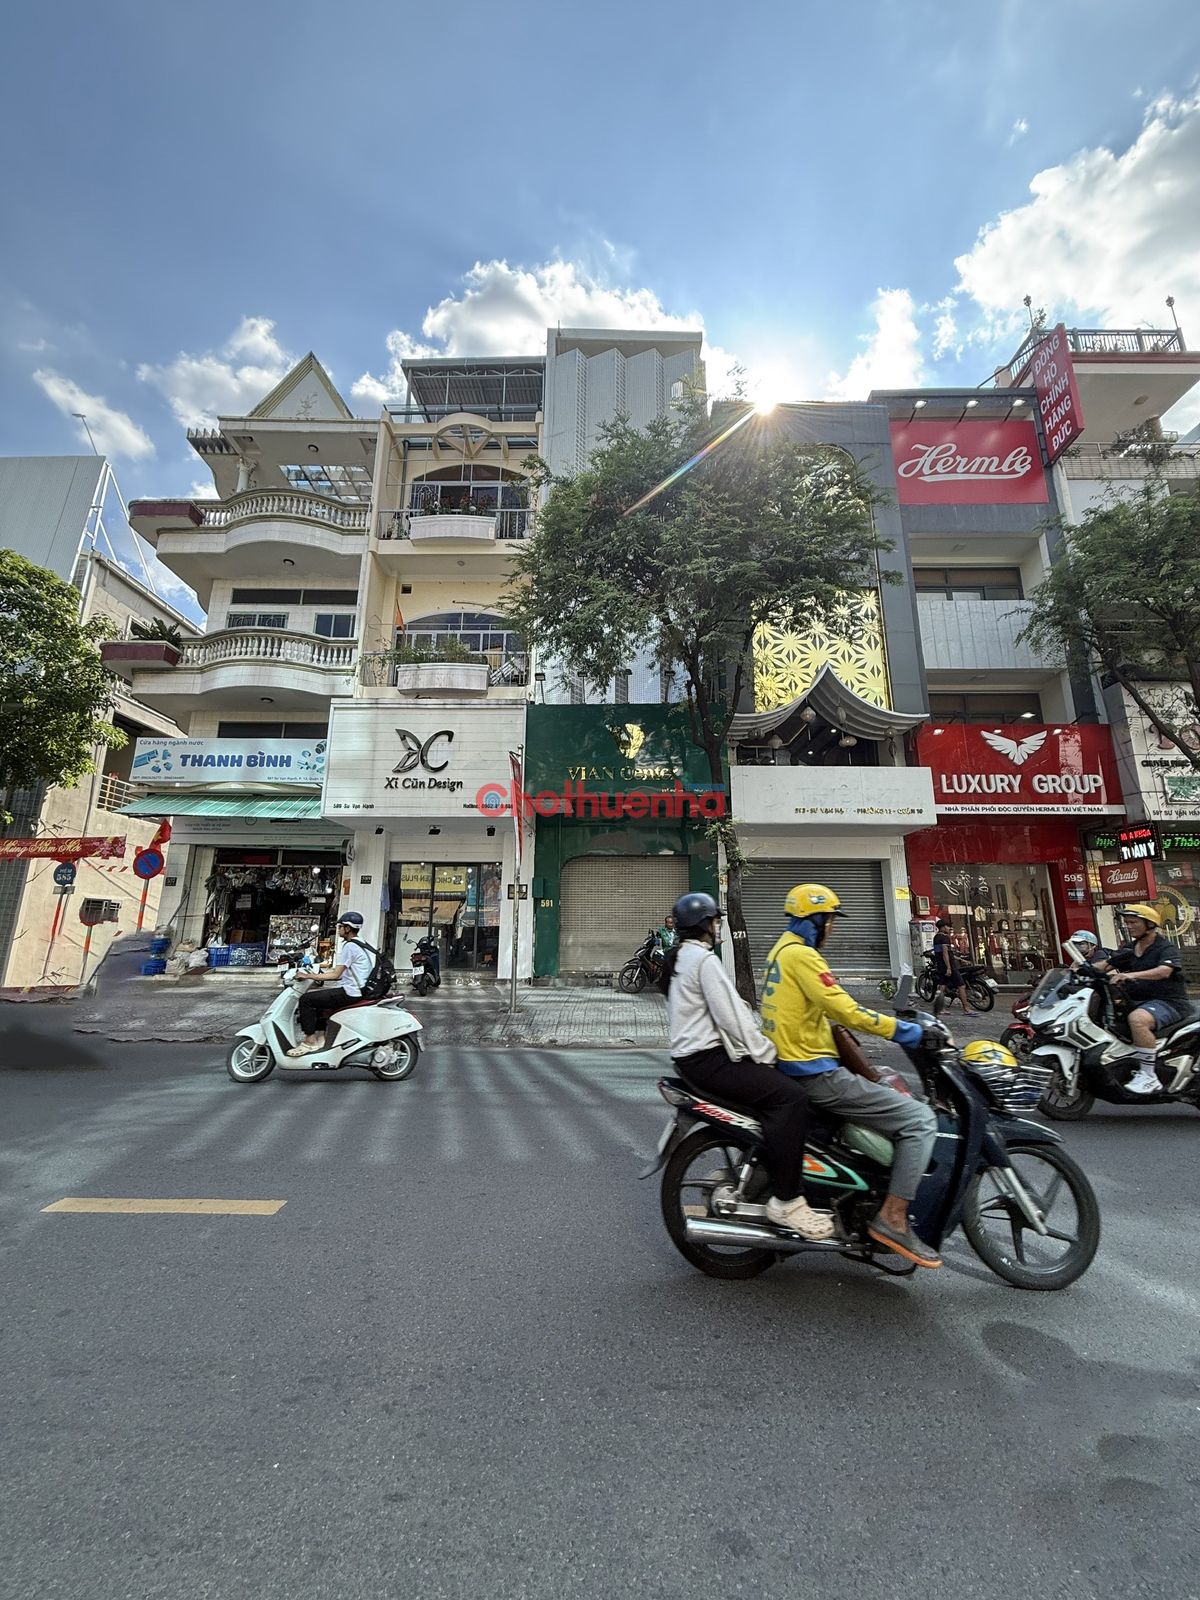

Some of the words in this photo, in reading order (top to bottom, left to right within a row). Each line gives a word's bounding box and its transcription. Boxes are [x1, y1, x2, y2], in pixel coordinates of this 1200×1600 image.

[1034, 332, 1060, 375] ĐỒNG
[1044, 361, 1057, 386] HỒ
[1040, 371, 1069, 416] CHÍNH
[1044, 396, 1072, 434] HÃNG
[1052, 420, 1072, 451] ĐỨC
[898, 443, 1032, 482] Hermle
[180, 754, 243, 768] THANH
[246, 751, 292, 768] BÌNH
[428, 777, 464, 792] Design
[566, 766, 615, 782] VIAN
[940, 774, 1022, 794] LUXURY
[1032, 774, 1103, 794] GROUP
